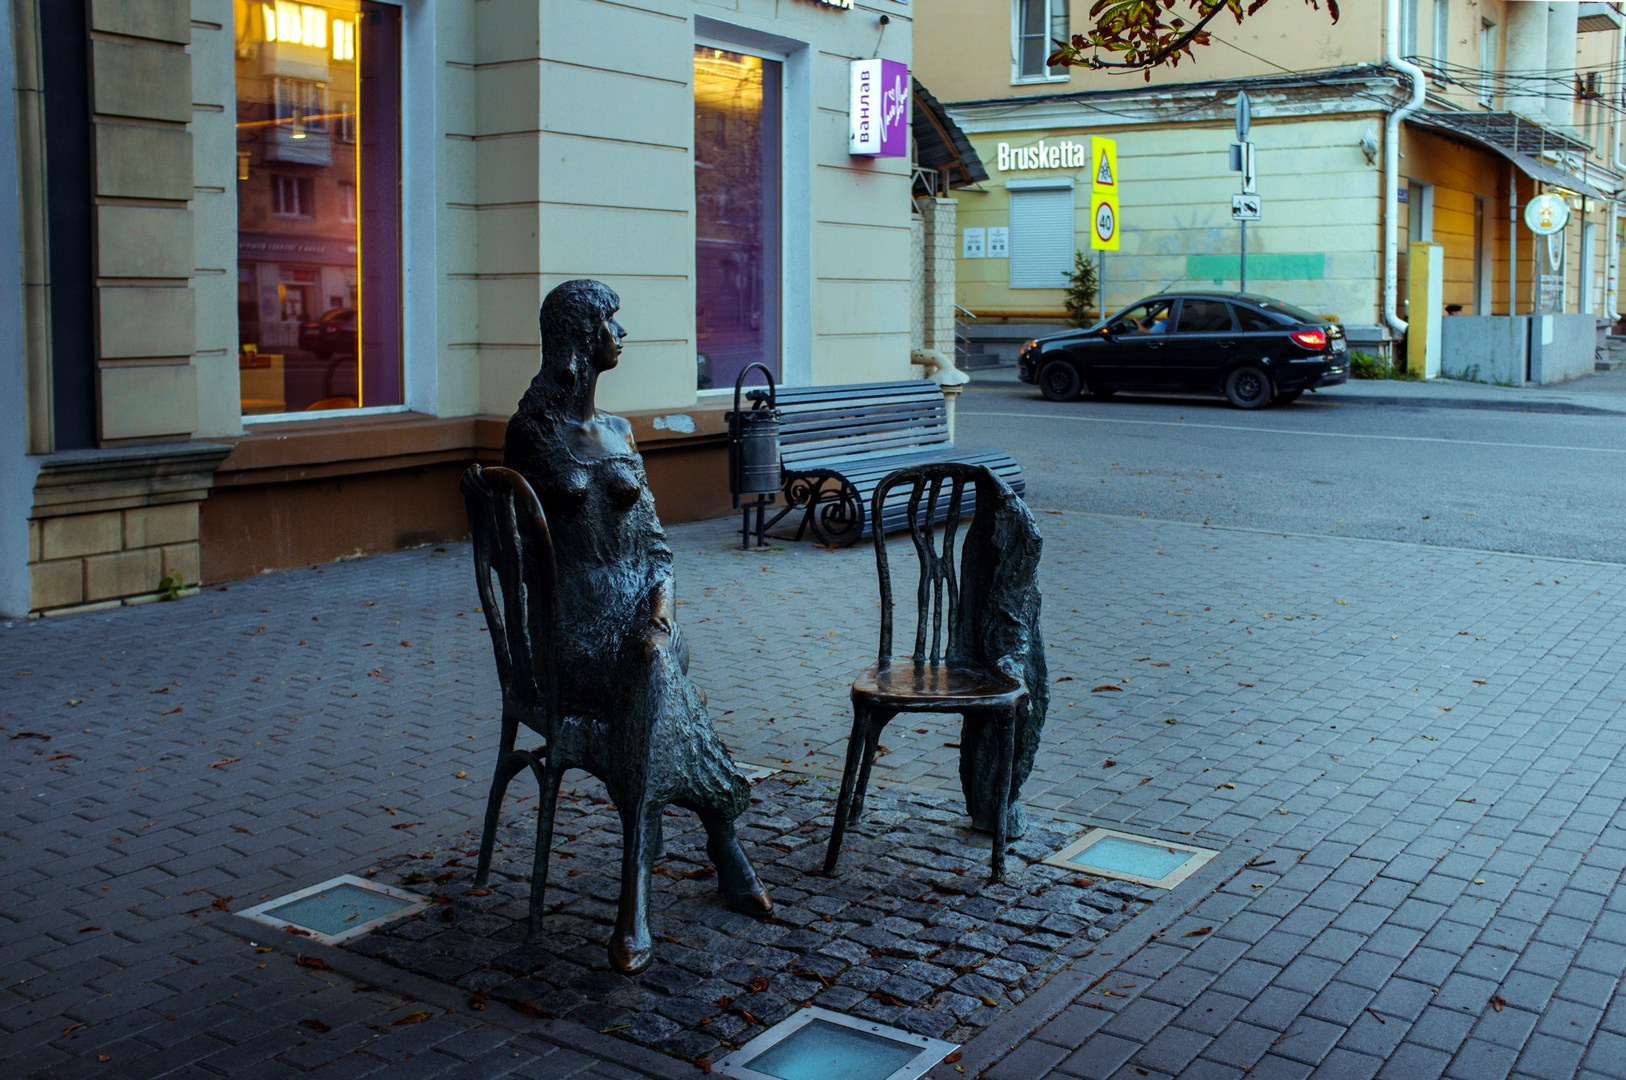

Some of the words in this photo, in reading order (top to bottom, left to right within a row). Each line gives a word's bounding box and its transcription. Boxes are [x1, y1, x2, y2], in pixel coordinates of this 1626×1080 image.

[860, 70, 870, 143] ванлав
[997, 140, 1085, 171] Brusketta
[1099, 214, 1112, 231] 40
